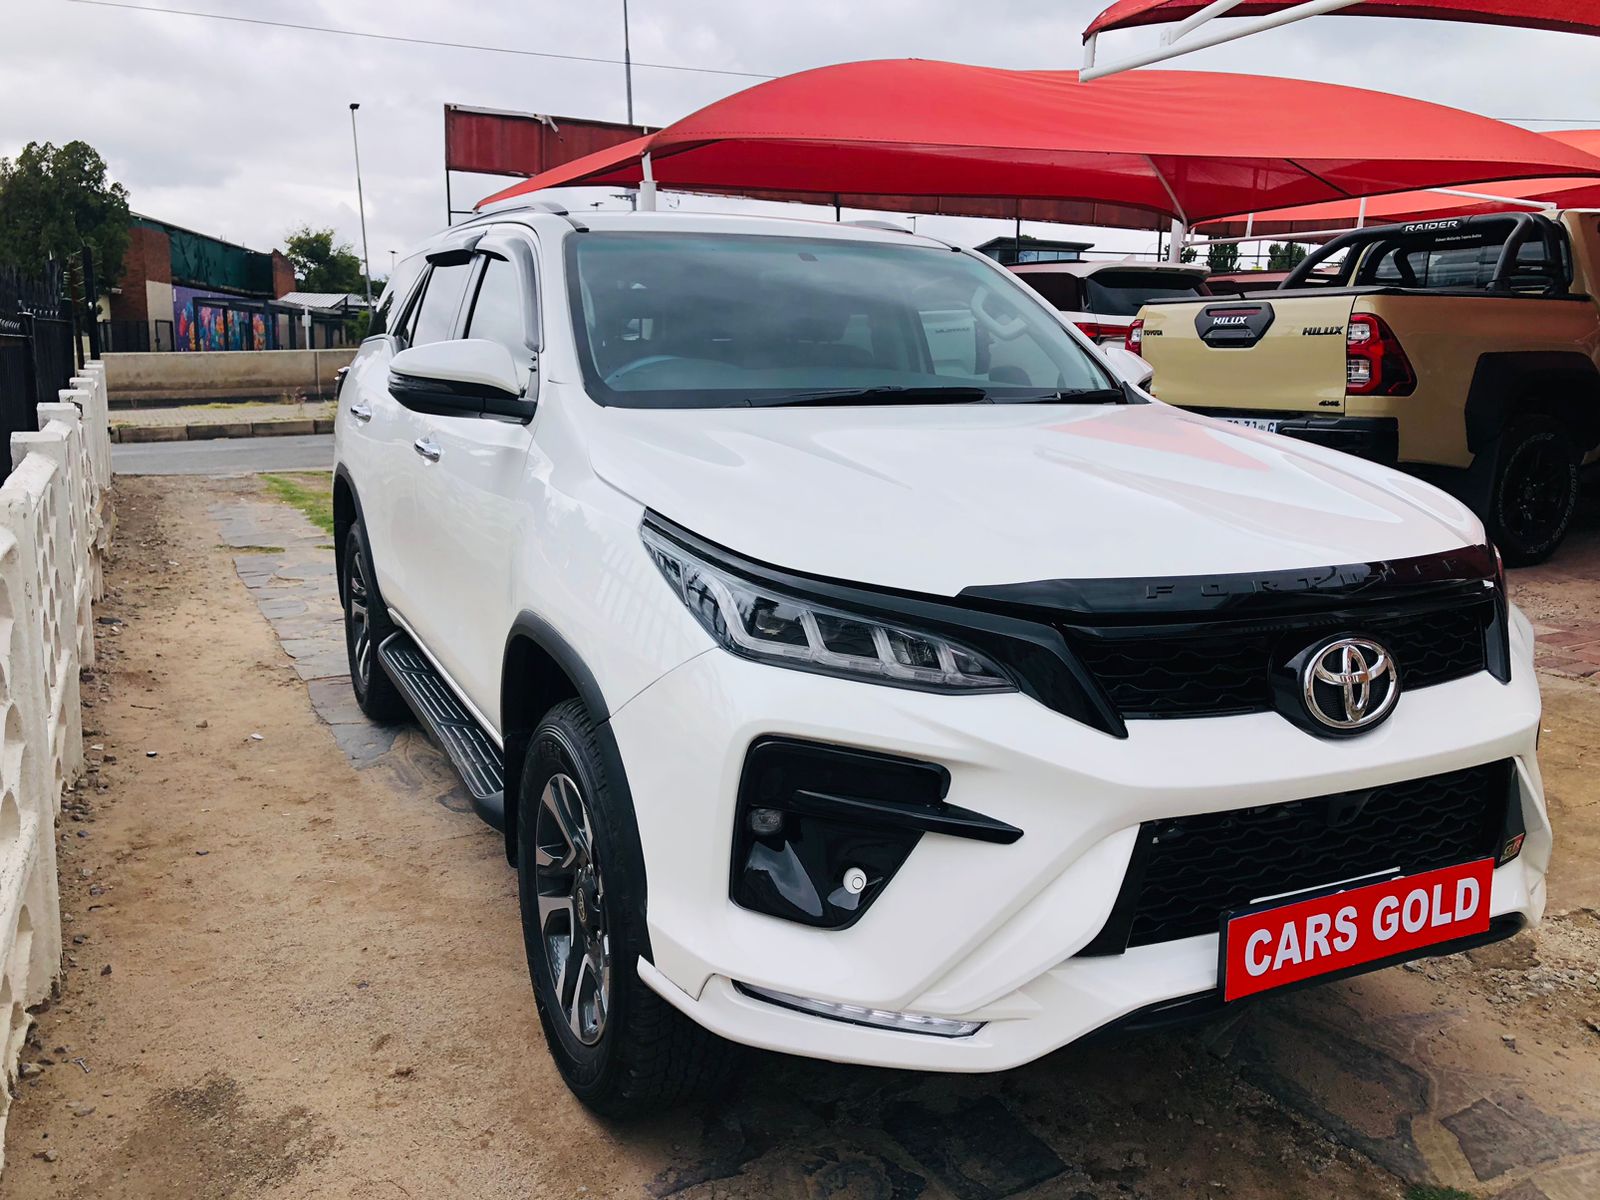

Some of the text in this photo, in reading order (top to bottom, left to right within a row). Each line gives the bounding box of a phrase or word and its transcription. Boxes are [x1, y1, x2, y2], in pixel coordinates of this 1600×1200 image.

[1405, 220, 1458, 232] RAIDER
[1213, 316, 1248, 325] HILUX
[1302, 326, 1344, 336] HILUX
[1244, 877, 1481, 977] CARS GOLD
